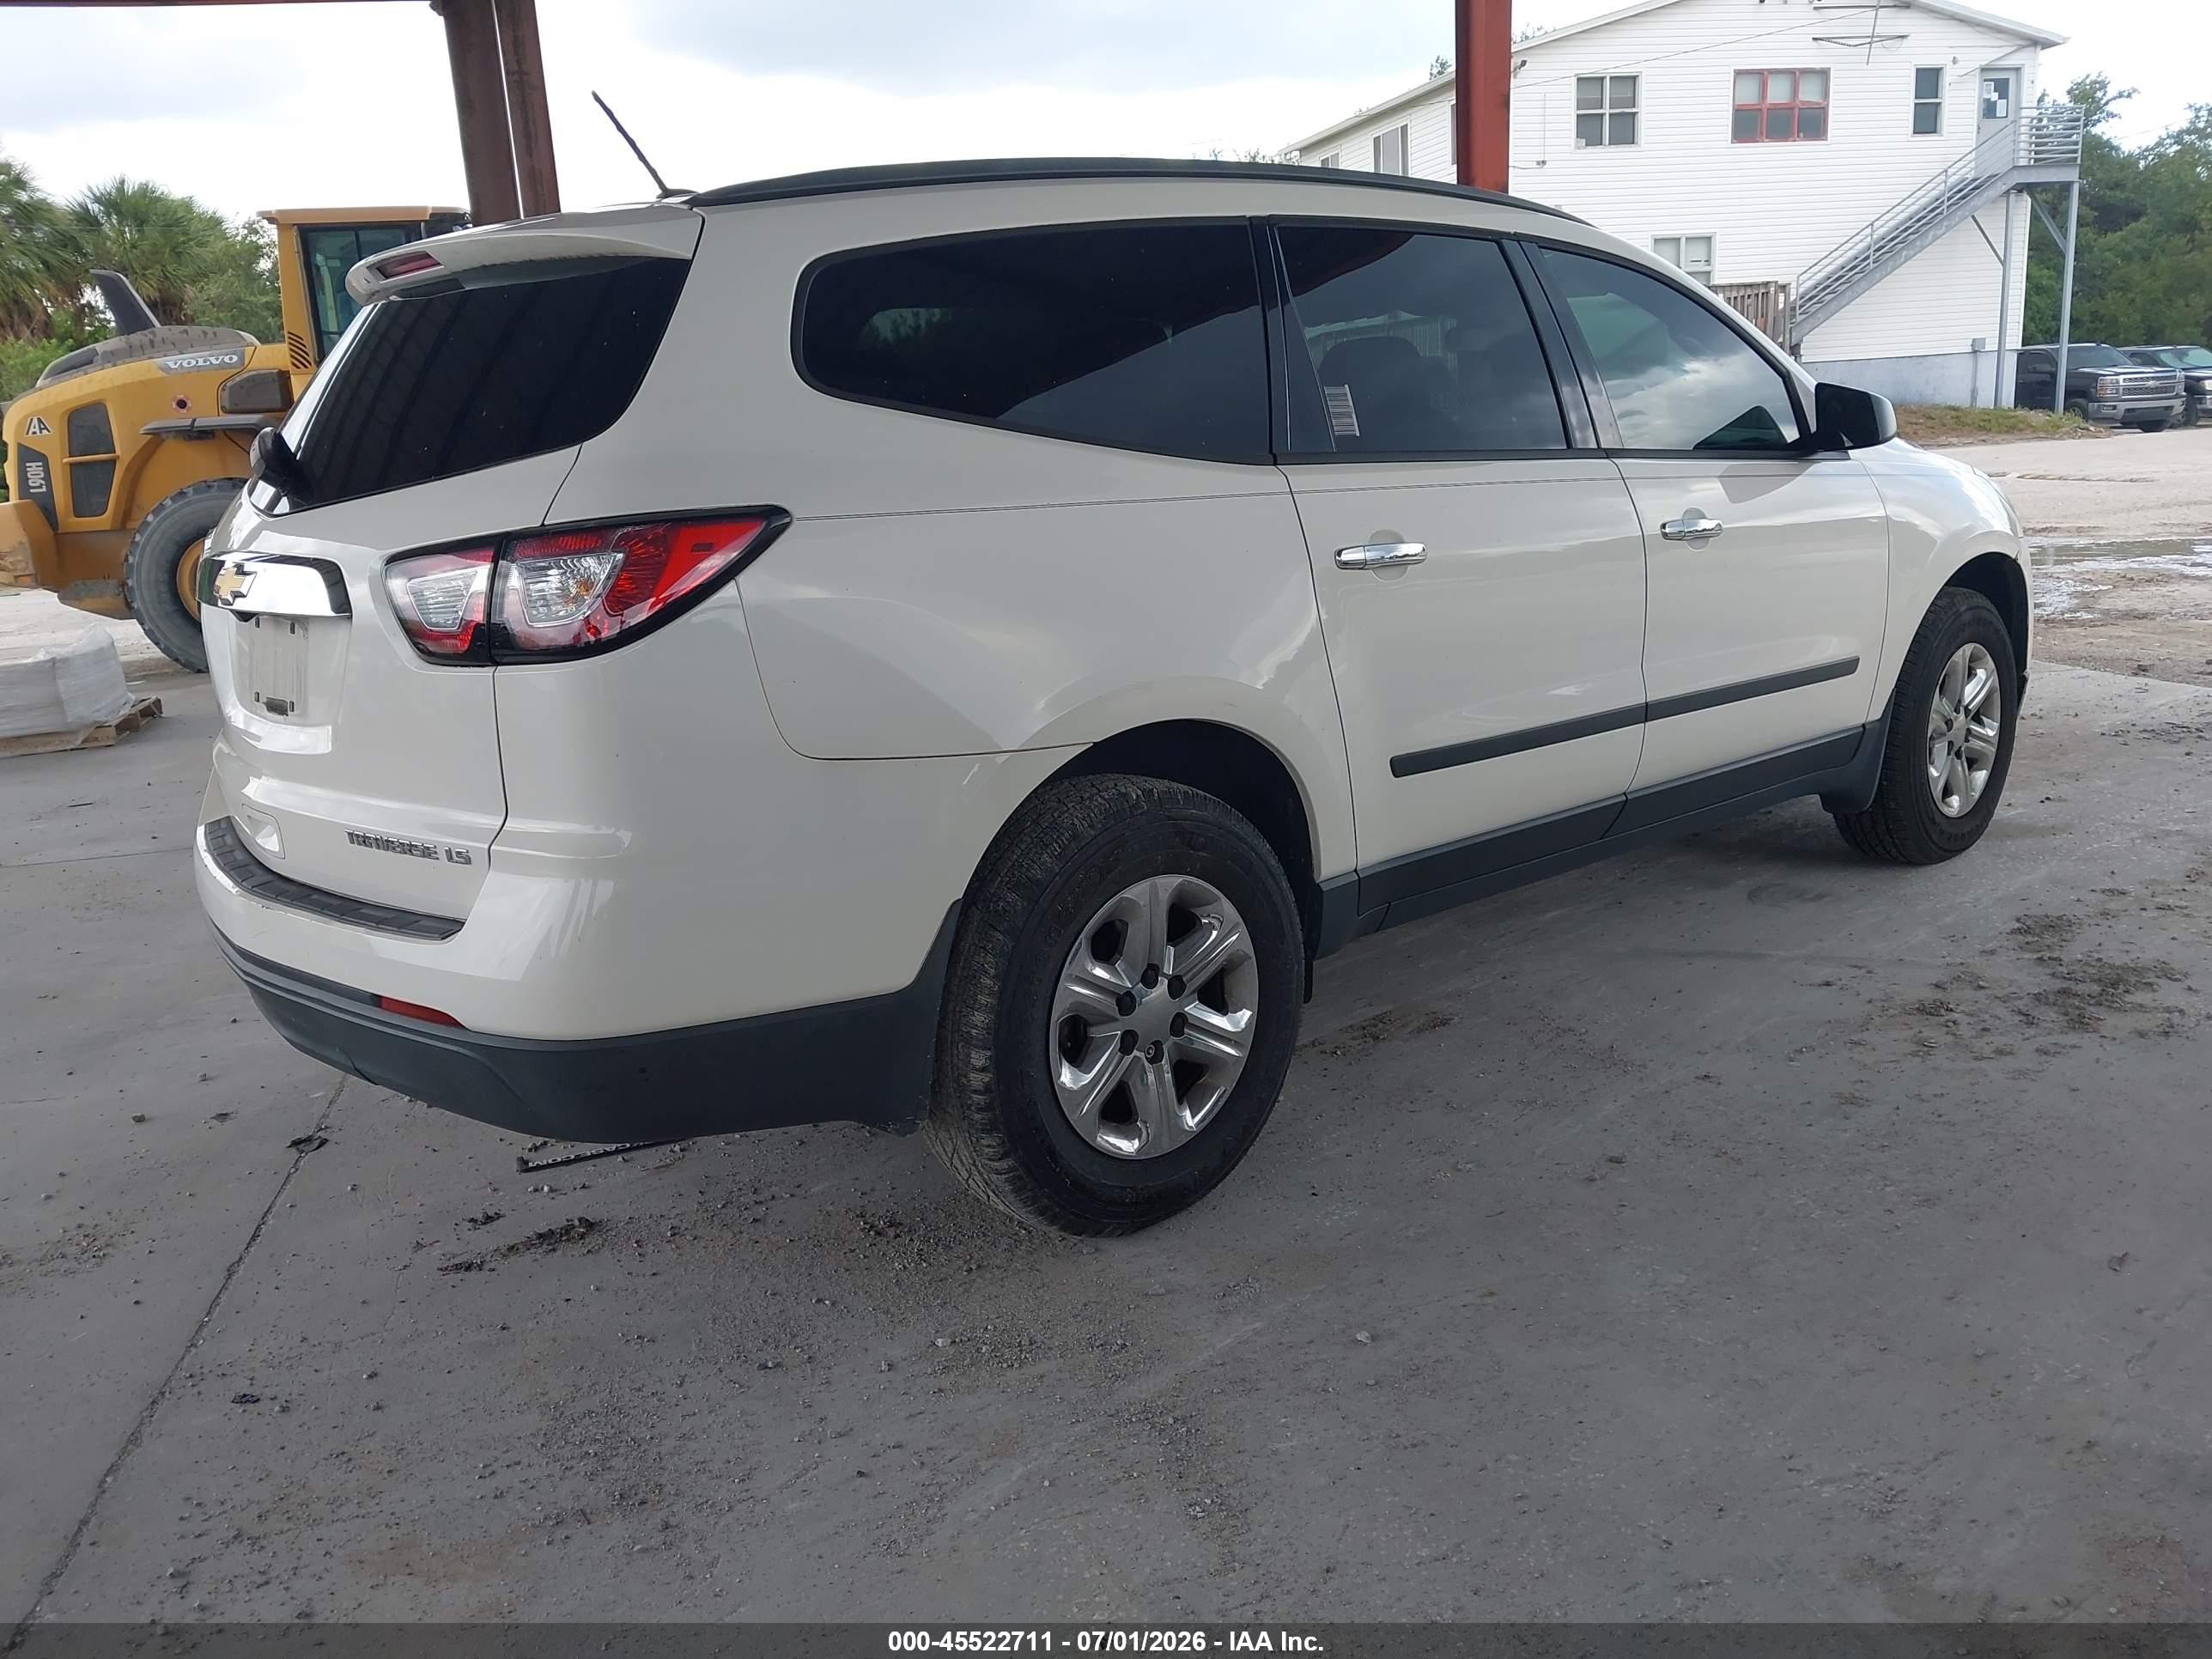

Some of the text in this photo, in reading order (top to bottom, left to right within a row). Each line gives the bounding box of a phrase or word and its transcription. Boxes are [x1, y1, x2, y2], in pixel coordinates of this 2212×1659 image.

[165, 355, 238, 369] VOLVO
[25, 461, 47, 493] L90H
[343, 829, 471, 865] TRAVERSE LS
